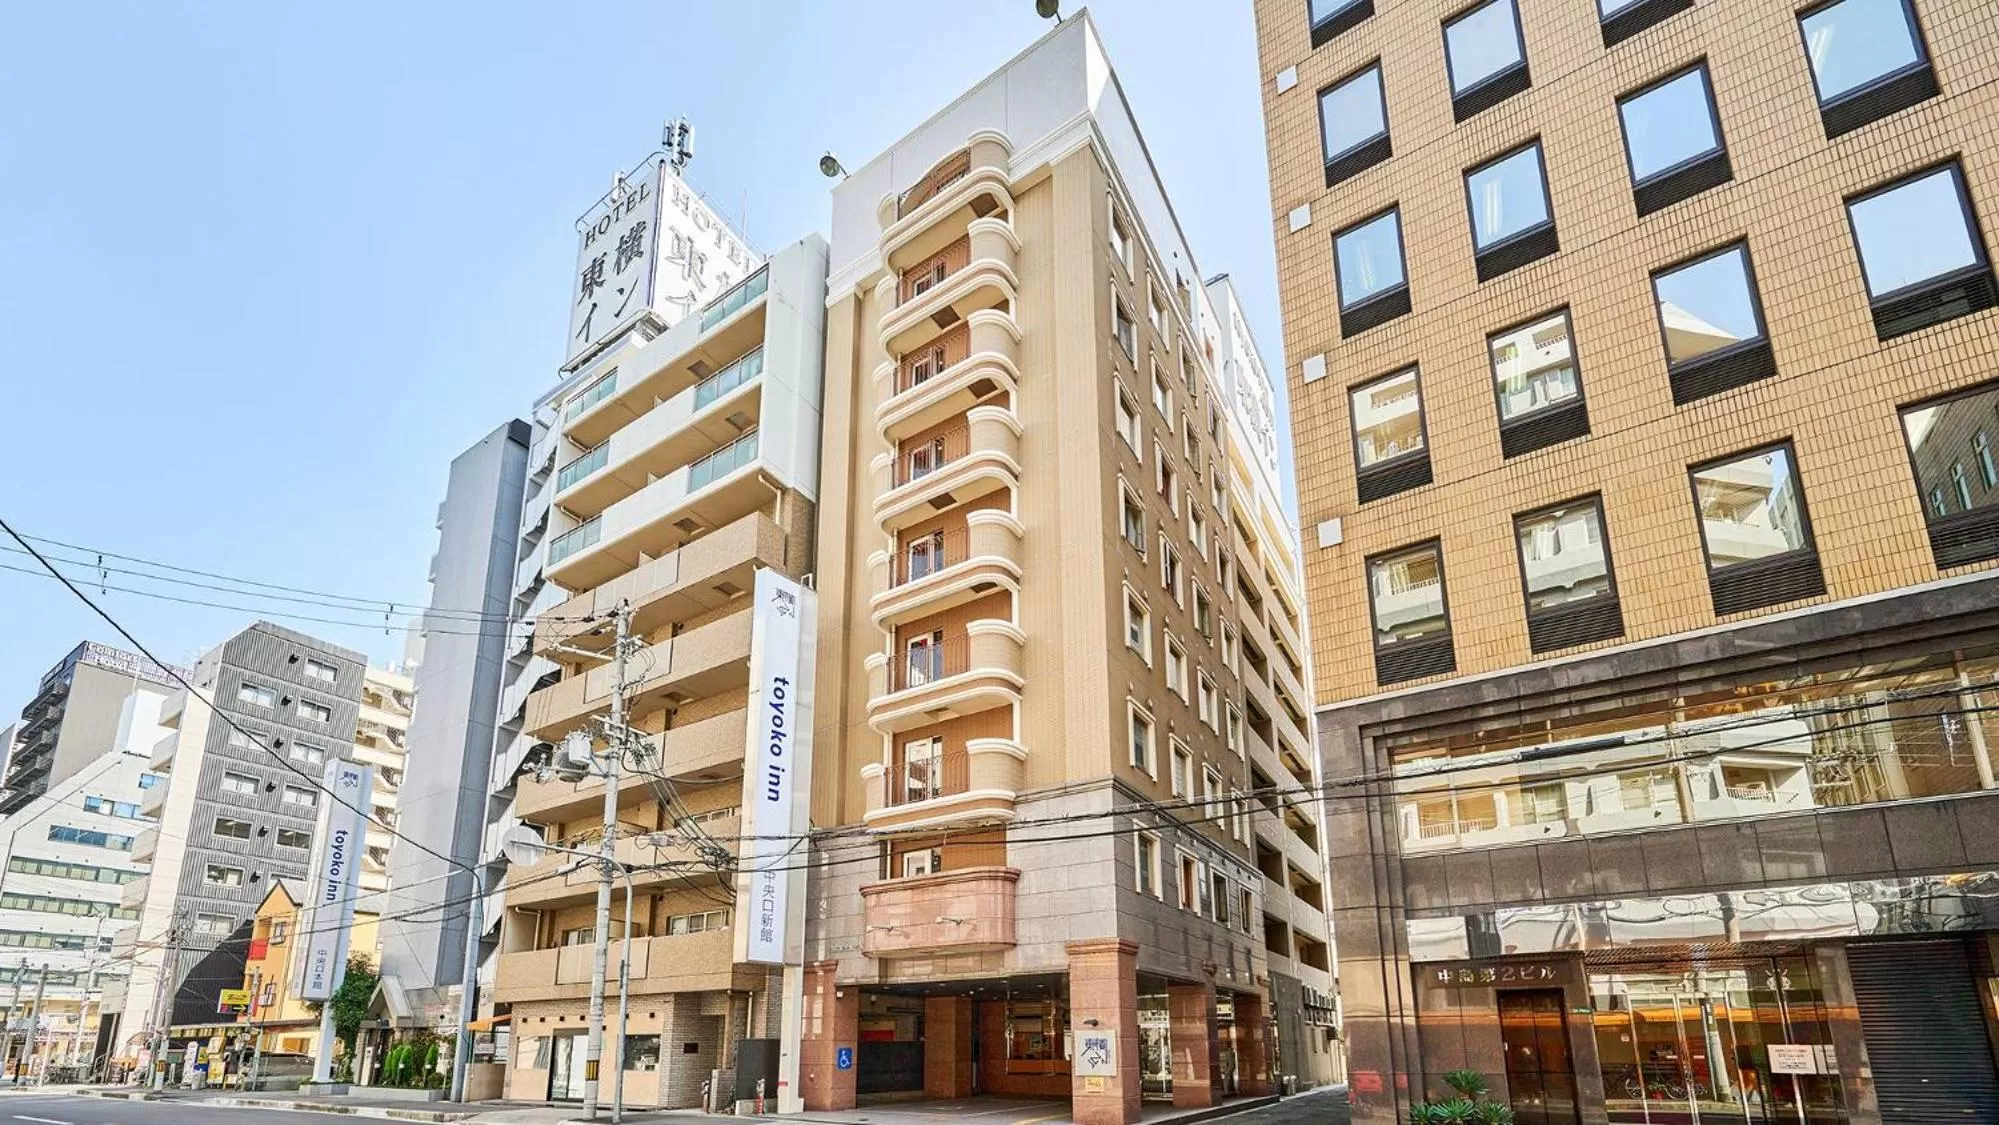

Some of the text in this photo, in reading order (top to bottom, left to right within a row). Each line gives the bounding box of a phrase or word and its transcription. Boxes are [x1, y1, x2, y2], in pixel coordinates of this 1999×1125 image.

[584, 182, 651, 250] HOTEL
[767, 676, 790, 802] toyoko inn
[326, 829, 349, 901] toyoko inn
